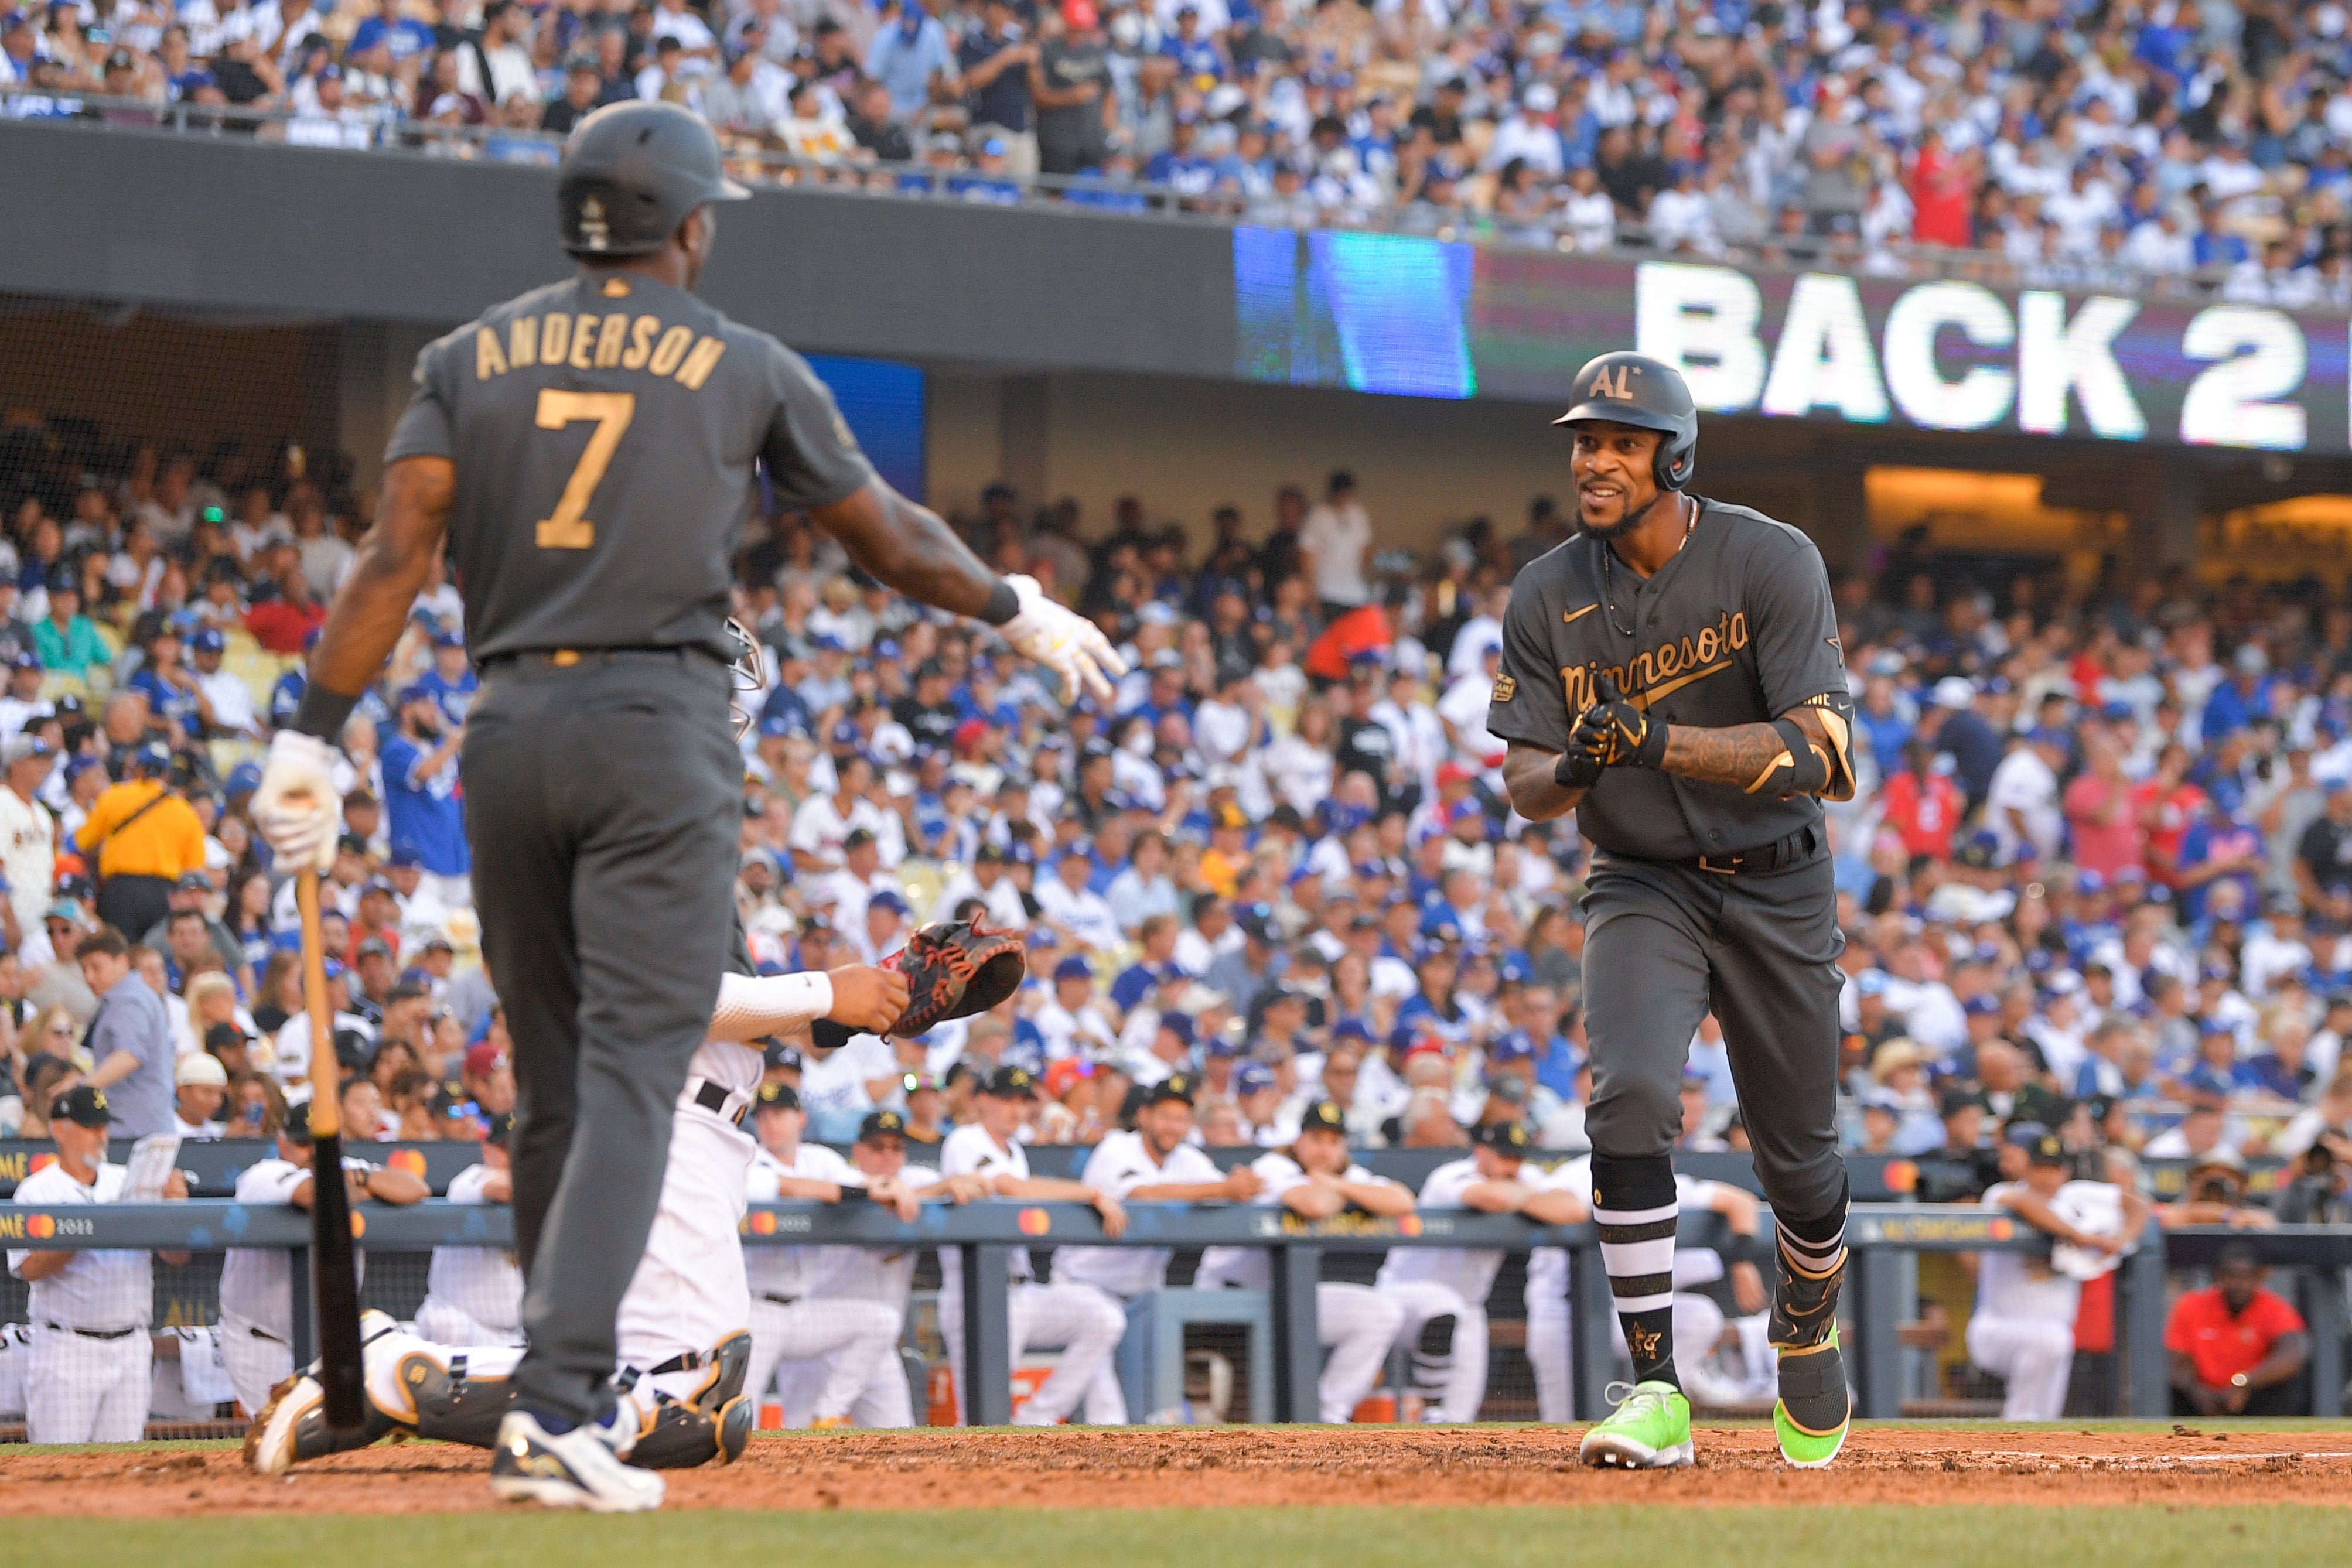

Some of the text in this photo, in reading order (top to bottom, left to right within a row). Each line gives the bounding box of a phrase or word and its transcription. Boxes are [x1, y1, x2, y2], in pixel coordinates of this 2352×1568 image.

[476, 312, 726, 391] ANDERSON
[1588, 364, 1633, 400] AL
[1635, 260, 2149, 441] BACK
[2180, 304, 2309, 452] 2
[534, 387, 637, 549] 7
[1560, 611, 1749, 718] Minnesota
